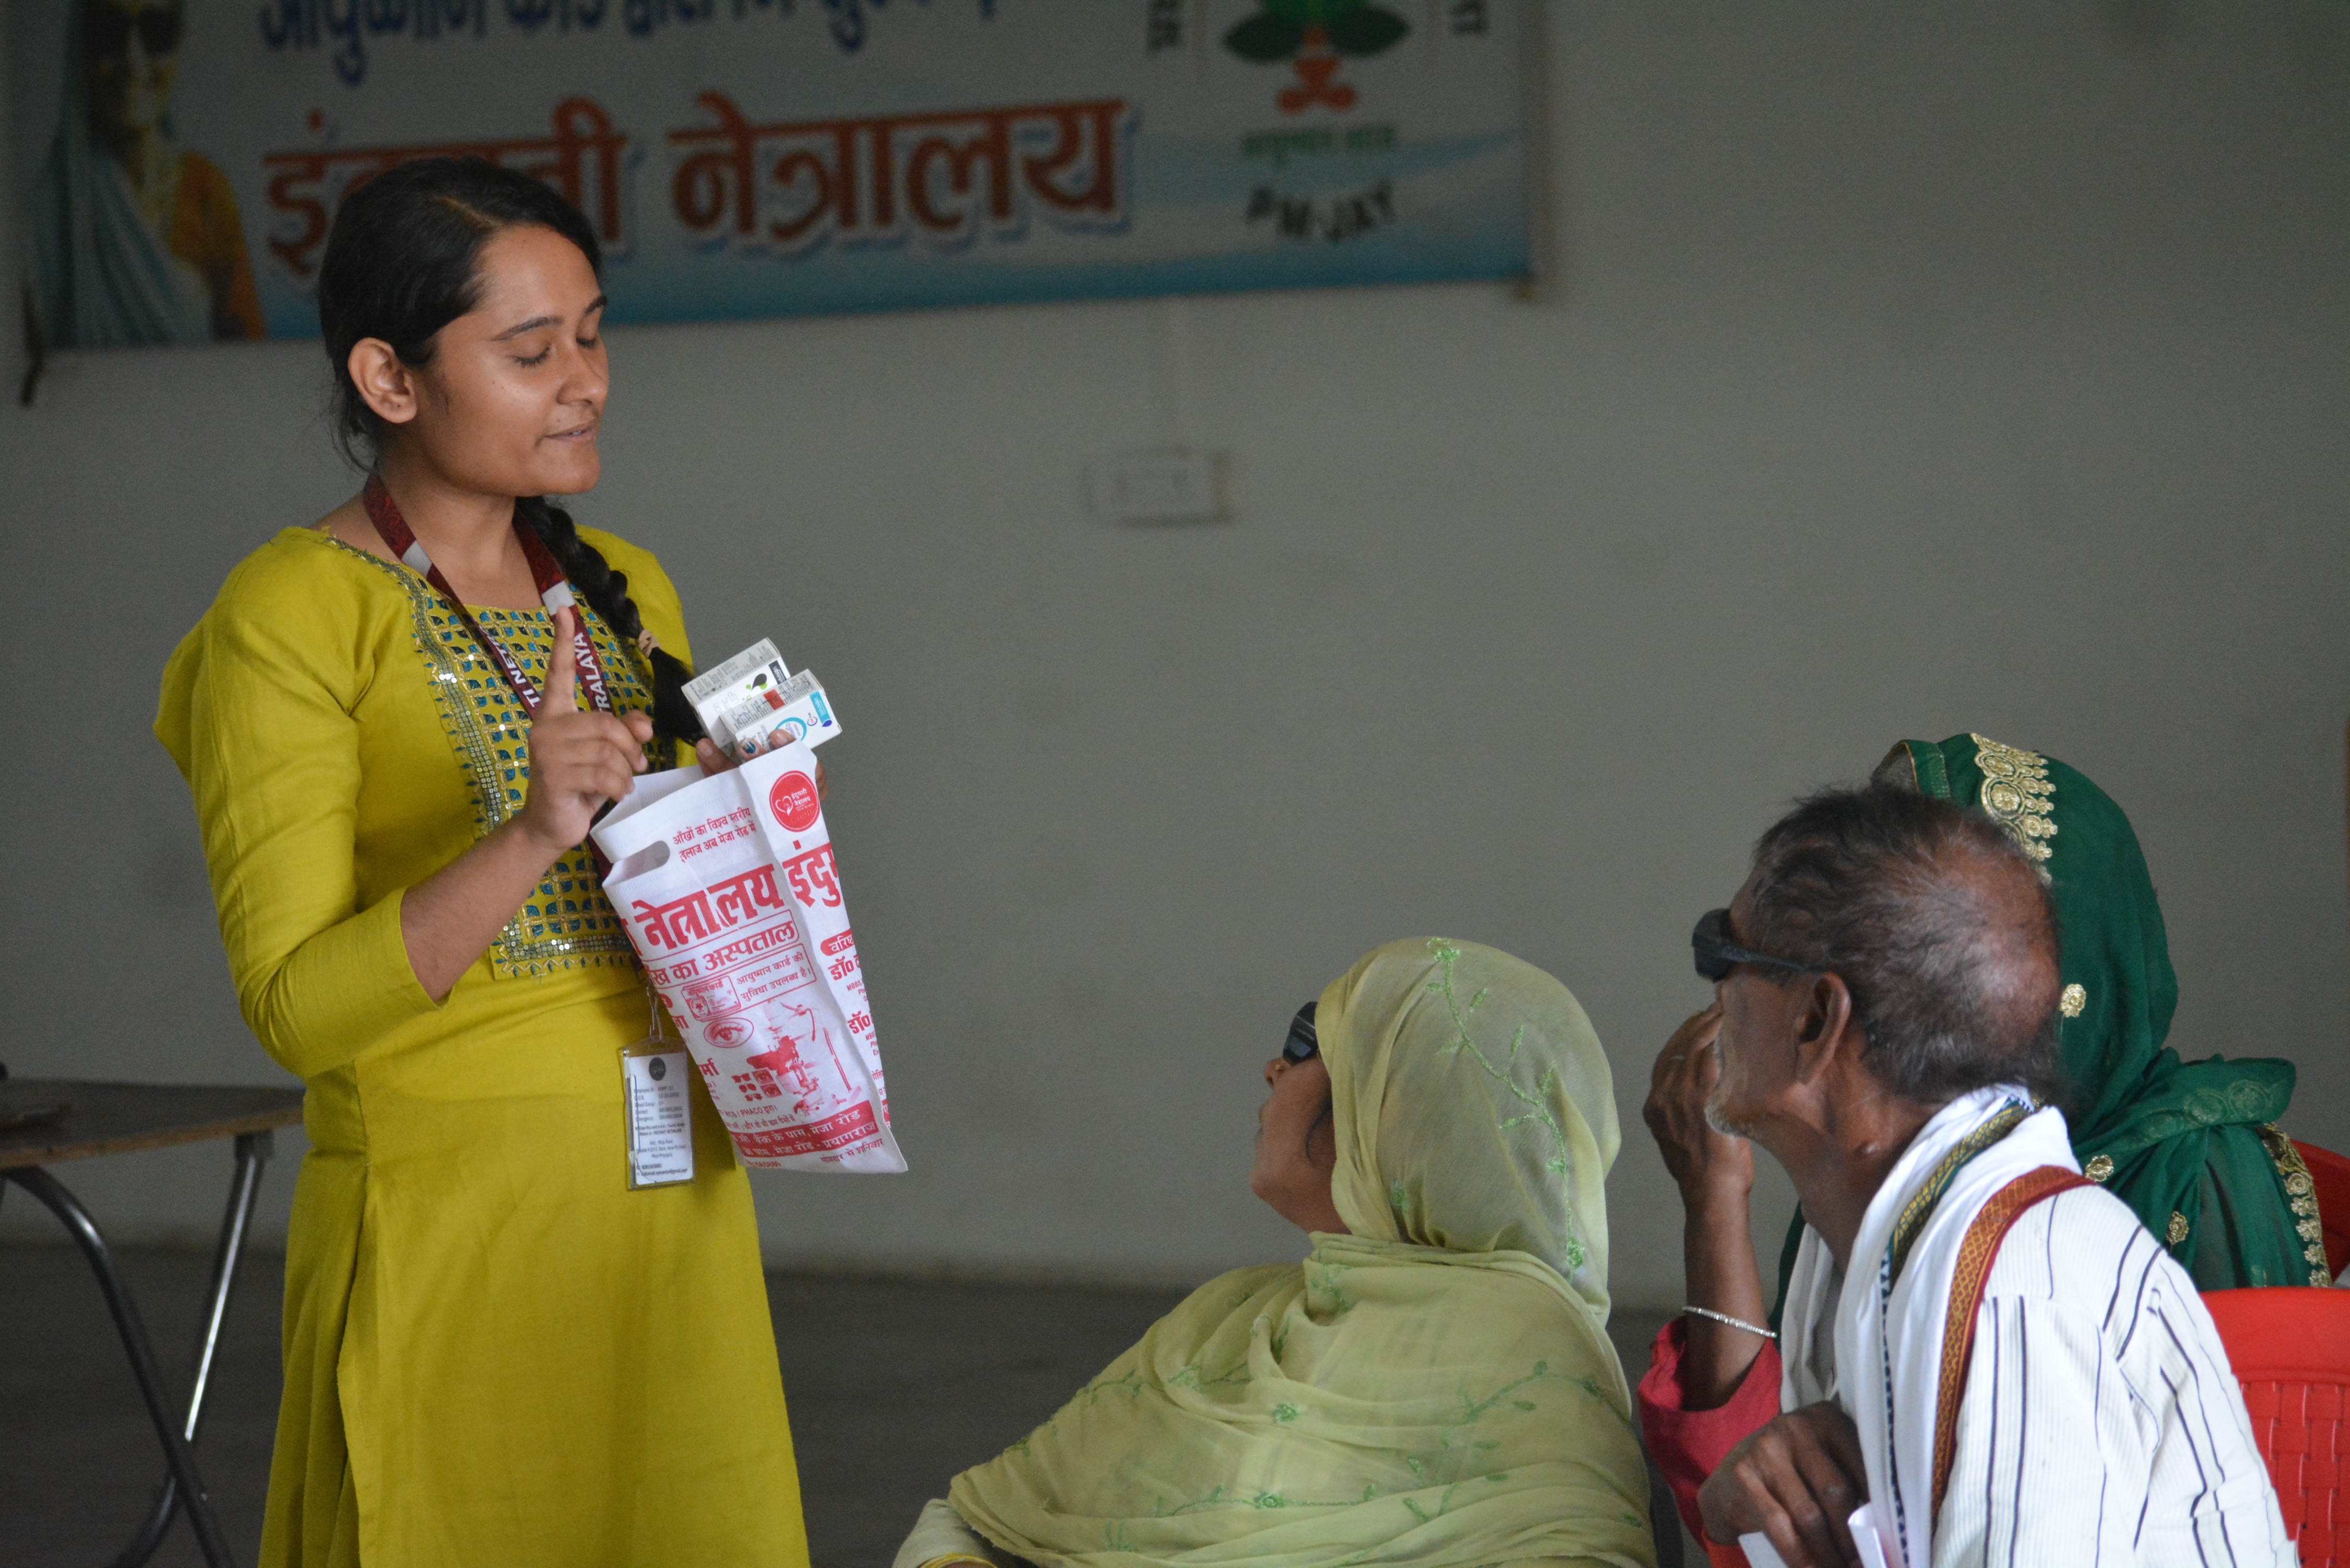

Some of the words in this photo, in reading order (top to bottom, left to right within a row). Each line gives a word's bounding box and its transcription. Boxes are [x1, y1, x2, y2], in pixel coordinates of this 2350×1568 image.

[667, 89, 1127, 242] नेत्रालय
[574, 632, 612, 713] RALAYA
[673, 827, 695, 845] आँखों
[695, 824, 708, 836] का
[707, 816, 729, 832] विश्व
[729, 807, 751, 823] स्तरीय
[678, 844, 702, 863] इलाज
[704, 838, 718, 851] अब
[717, 832, 735, 844] मेजा
[735, 825, 750, 837] रोड
[748, 820, 757, 832] में
[781, 840, 842, 907] इंदु
[670, 959, 700, 980] का
[702, 920, 796, 971] अस्पताल
[736, 965, 771, 985] आयुष्मान
[774, 956, 791, 971] कार्ड
[792, 951, 805, 962] की
[741, 983, 768, 1002] सुविधा
[768, 970, 799, 990] उपलब्ध
[740, 1106, 763, 1116] PHACO
[770, 1131, 784, 1141] के
[809, 1122, 834, 1135] मेजा
[836, 1109, 861, 1125] रोड
[794, 1141, 814, 1151] रोड
[822, 1122, 876, 1149] प्रयागराज
[845, 1148, 855, 1157] से
[856, 1138, 884, 1155] शनिवार
